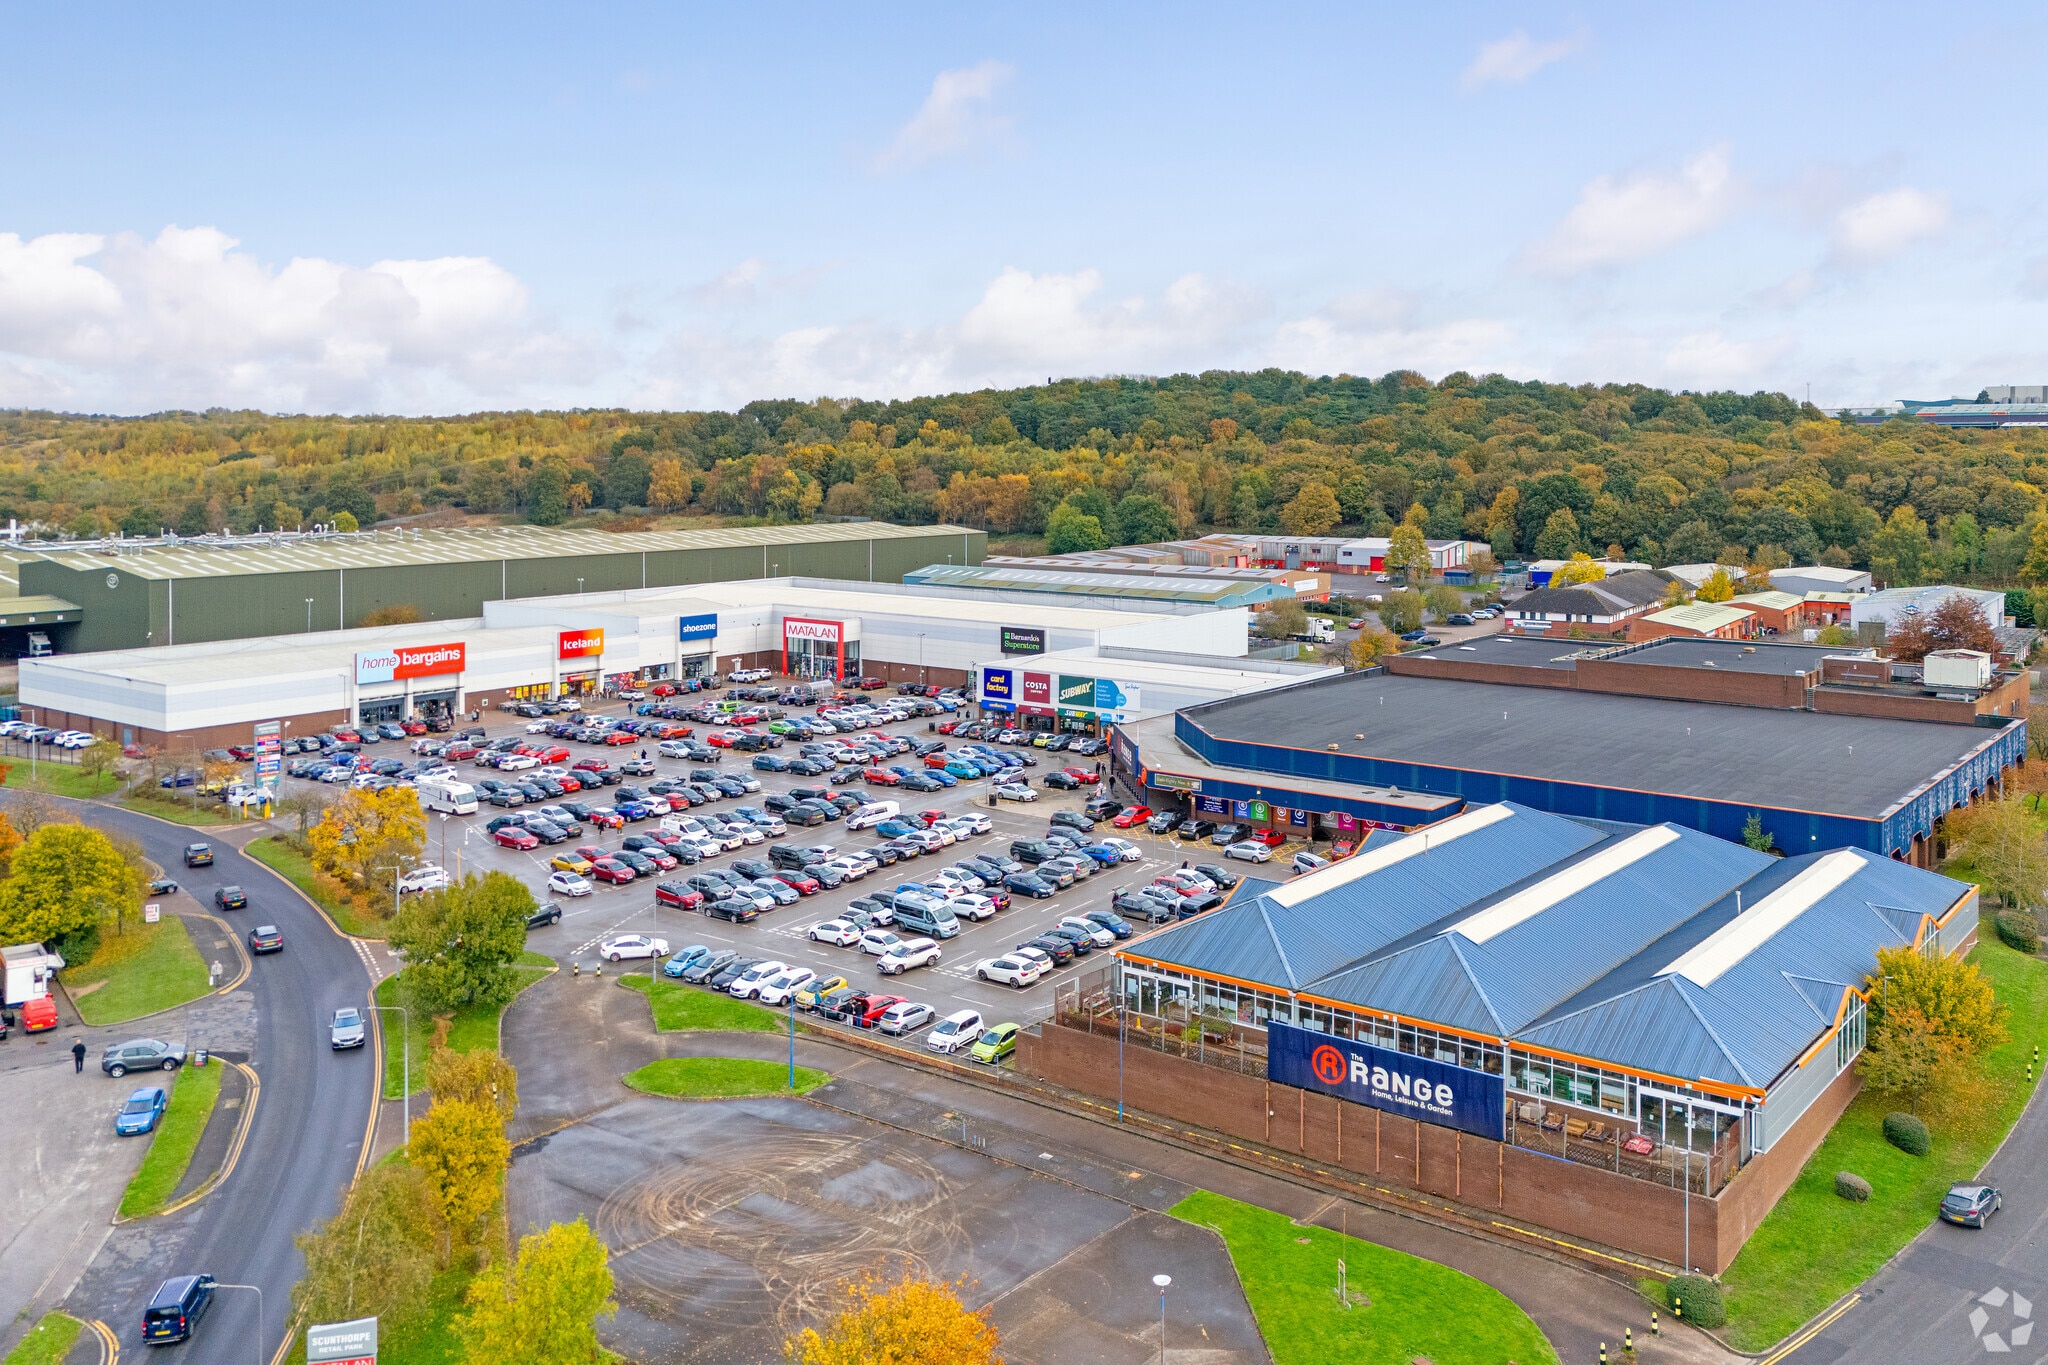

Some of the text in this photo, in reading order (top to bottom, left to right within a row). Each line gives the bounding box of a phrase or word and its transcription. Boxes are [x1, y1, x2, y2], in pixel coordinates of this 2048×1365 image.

[682, 622, 716, 633] shoezone
[788, 625, 836, 639] MATALAN
[563, 637, 601, 650] Iceland
[1004, 640, 1040, 650] Superstore
[362, 656, 397, 669] home
[402, 648, 461, 666] bargains
[990, 675, 1005, 683] card
[986, 682, 1009, 694] factory
[1025, 681, 1048, 690] COSTA
[1059, 681, 1094, 700] SUBWAY
[1064, 709, 1088, 718] SUBWAY
[1350, 1053, 1364, 1062] The
[1395, 1094, 1419, 1107] Leisure
[1420, 1101, 1426, 1109] &
[1427, 1103, 1453, 1116] Garden
[312, 1332, 371, 1346] SCUNTHORPE
[319, 1343, 364, 1353] RETAIL PARK
